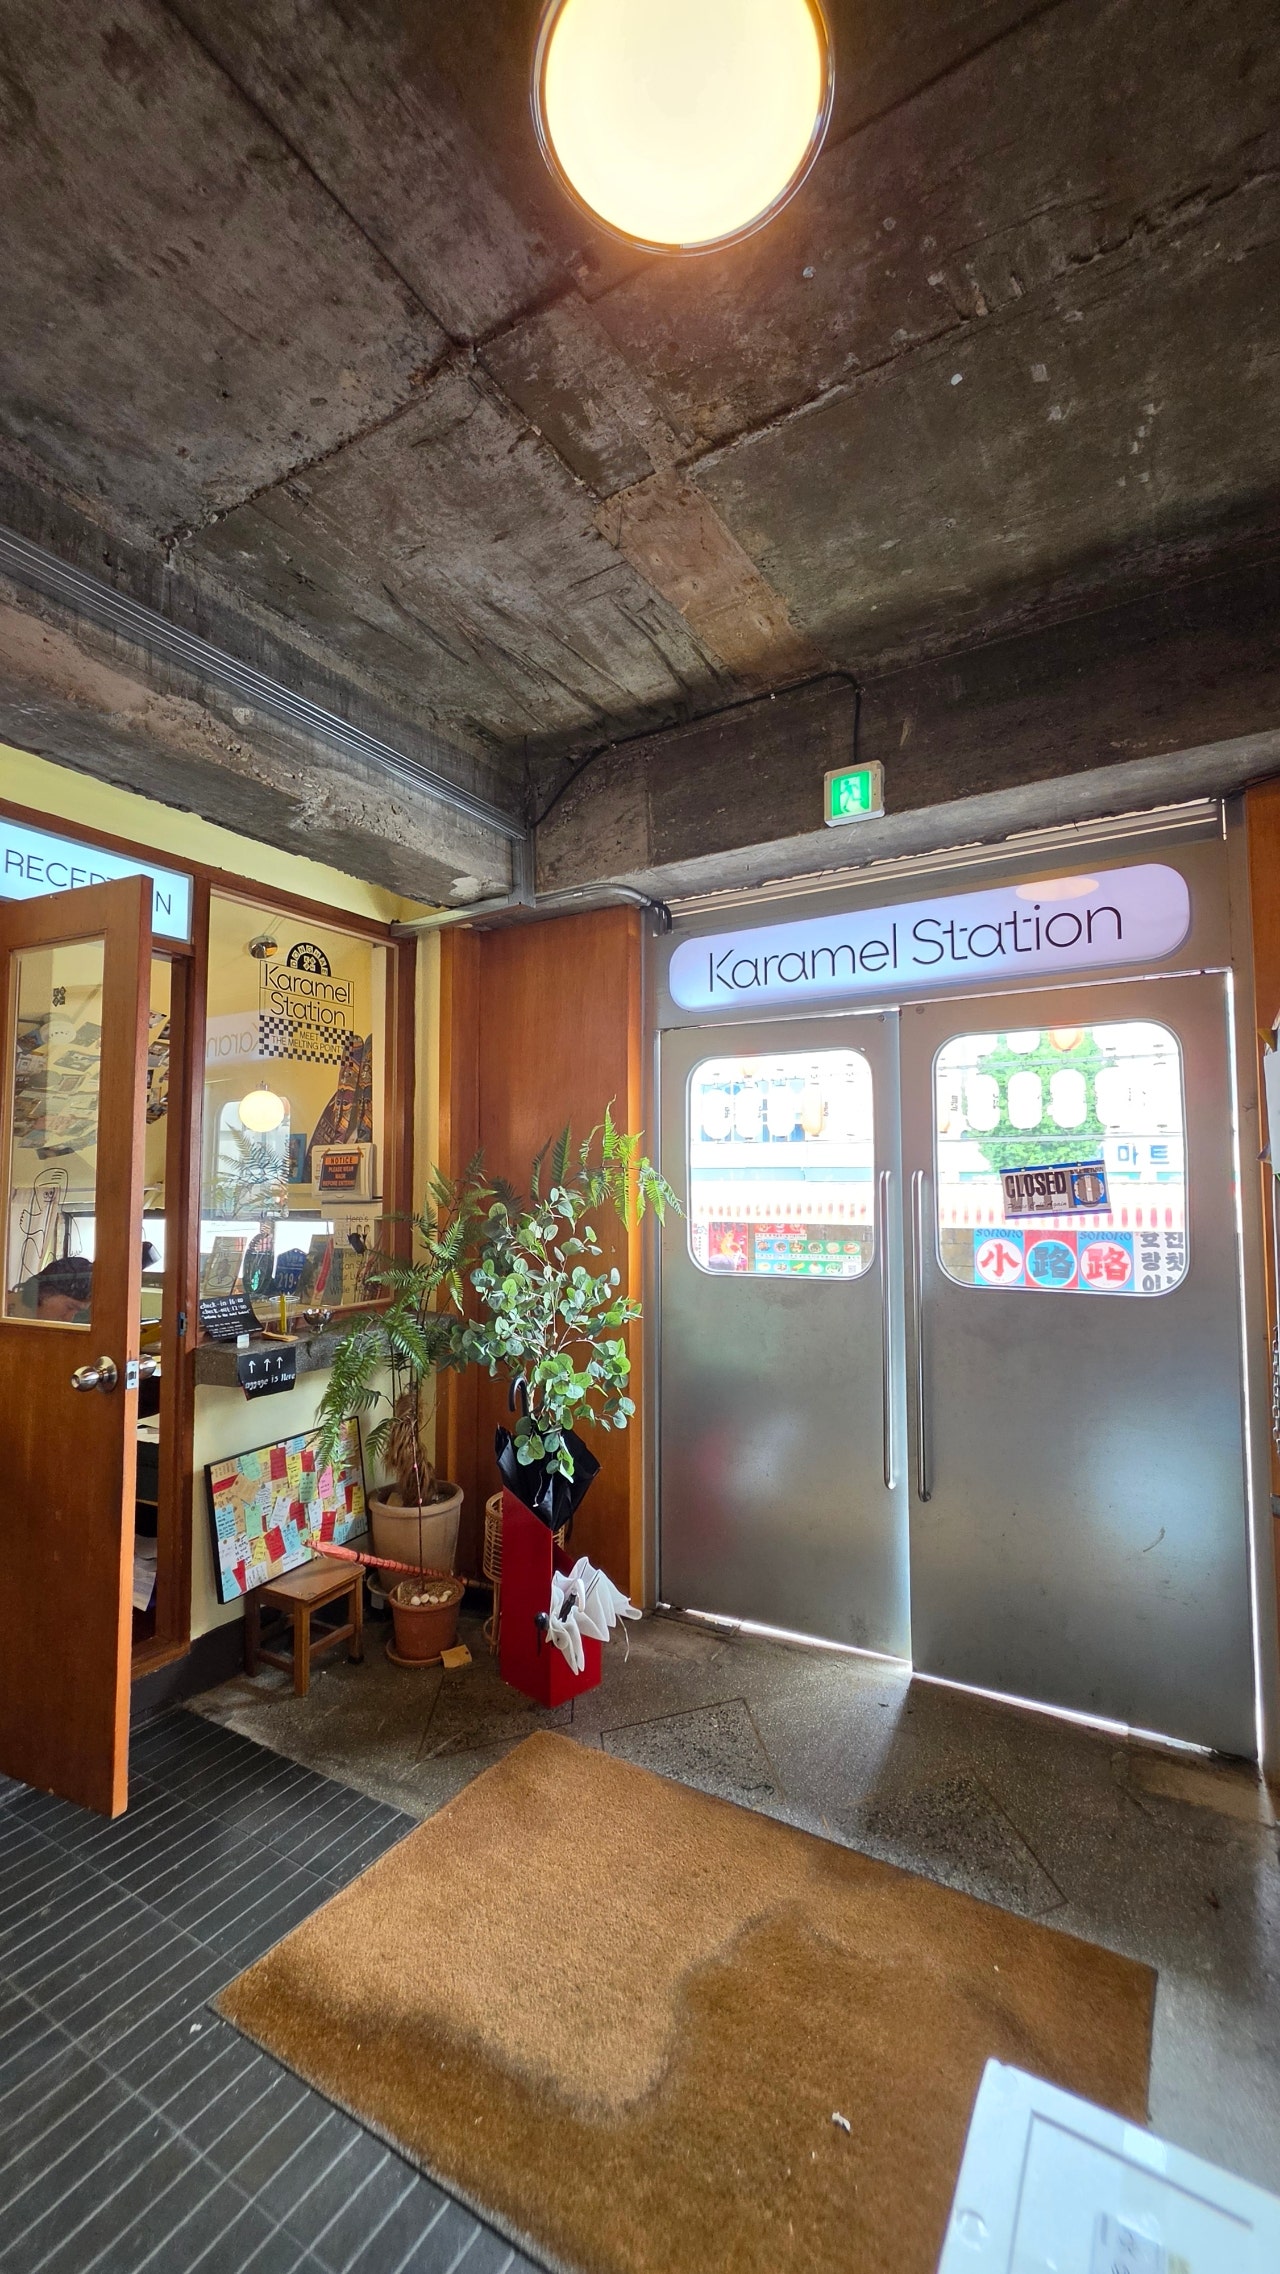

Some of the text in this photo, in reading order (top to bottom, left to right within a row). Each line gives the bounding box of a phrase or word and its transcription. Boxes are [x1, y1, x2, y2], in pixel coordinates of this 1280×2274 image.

[5, 848, 172, 916] RECEPN
[290, 945, 328, 975] DONGHAE
[709, 903, 1123, 993] Karamel Station
[265, 963, 350, 1004] Karamel
[270, 991, 346, 1027] Station
[271, 1035, 286, 1045] THE
[288, 1038, 318, 1050] MELTING
[299, 1031, 319, 1041] MEET
[1005, 1171, 1067, 1199] CLOSED
[271, 1374, 279, 1383] is
